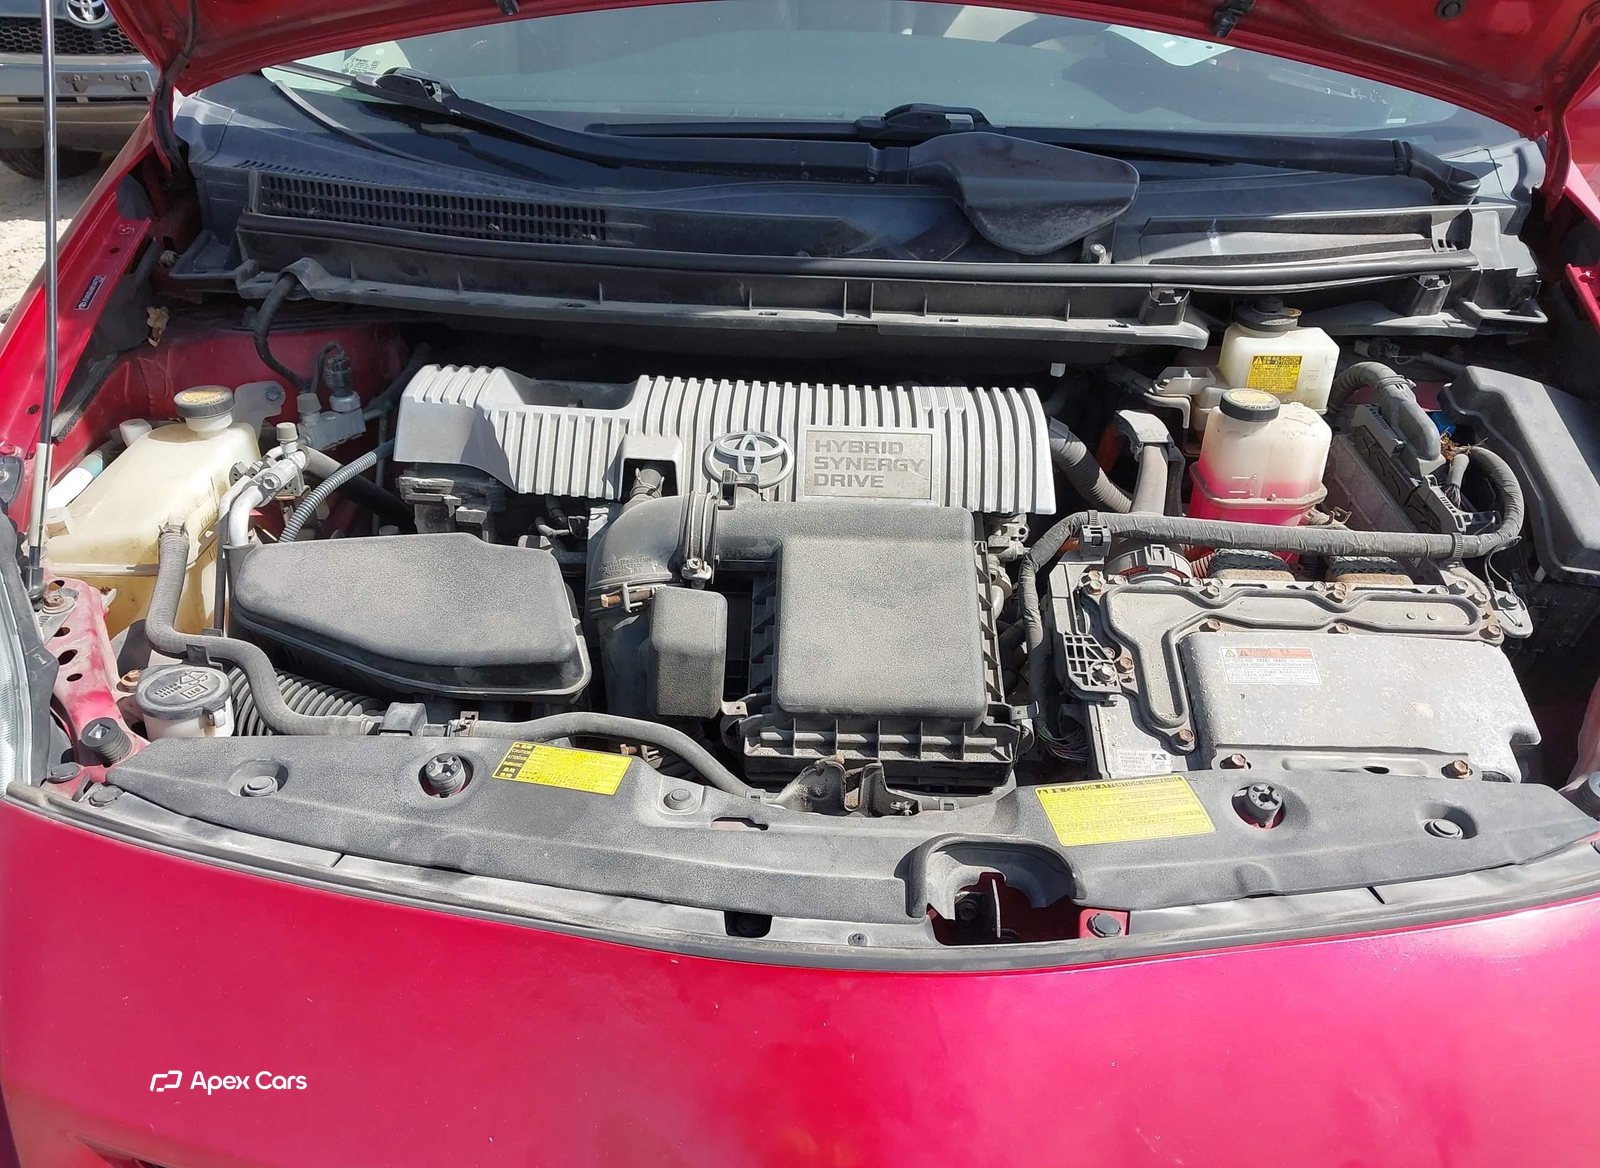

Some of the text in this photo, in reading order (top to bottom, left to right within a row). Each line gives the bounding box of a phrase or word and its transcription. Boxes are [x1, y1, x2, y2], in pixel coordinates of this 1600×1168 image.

[815, 439, 904, 455] HYBRID
[814, 456, 925, 472] SYNERGY
[813, 473, 884, 488] DRIVE
[1064, 784, 1096, 792] CAUTION
[1100, 780, 1139, 788] ATTENTION
